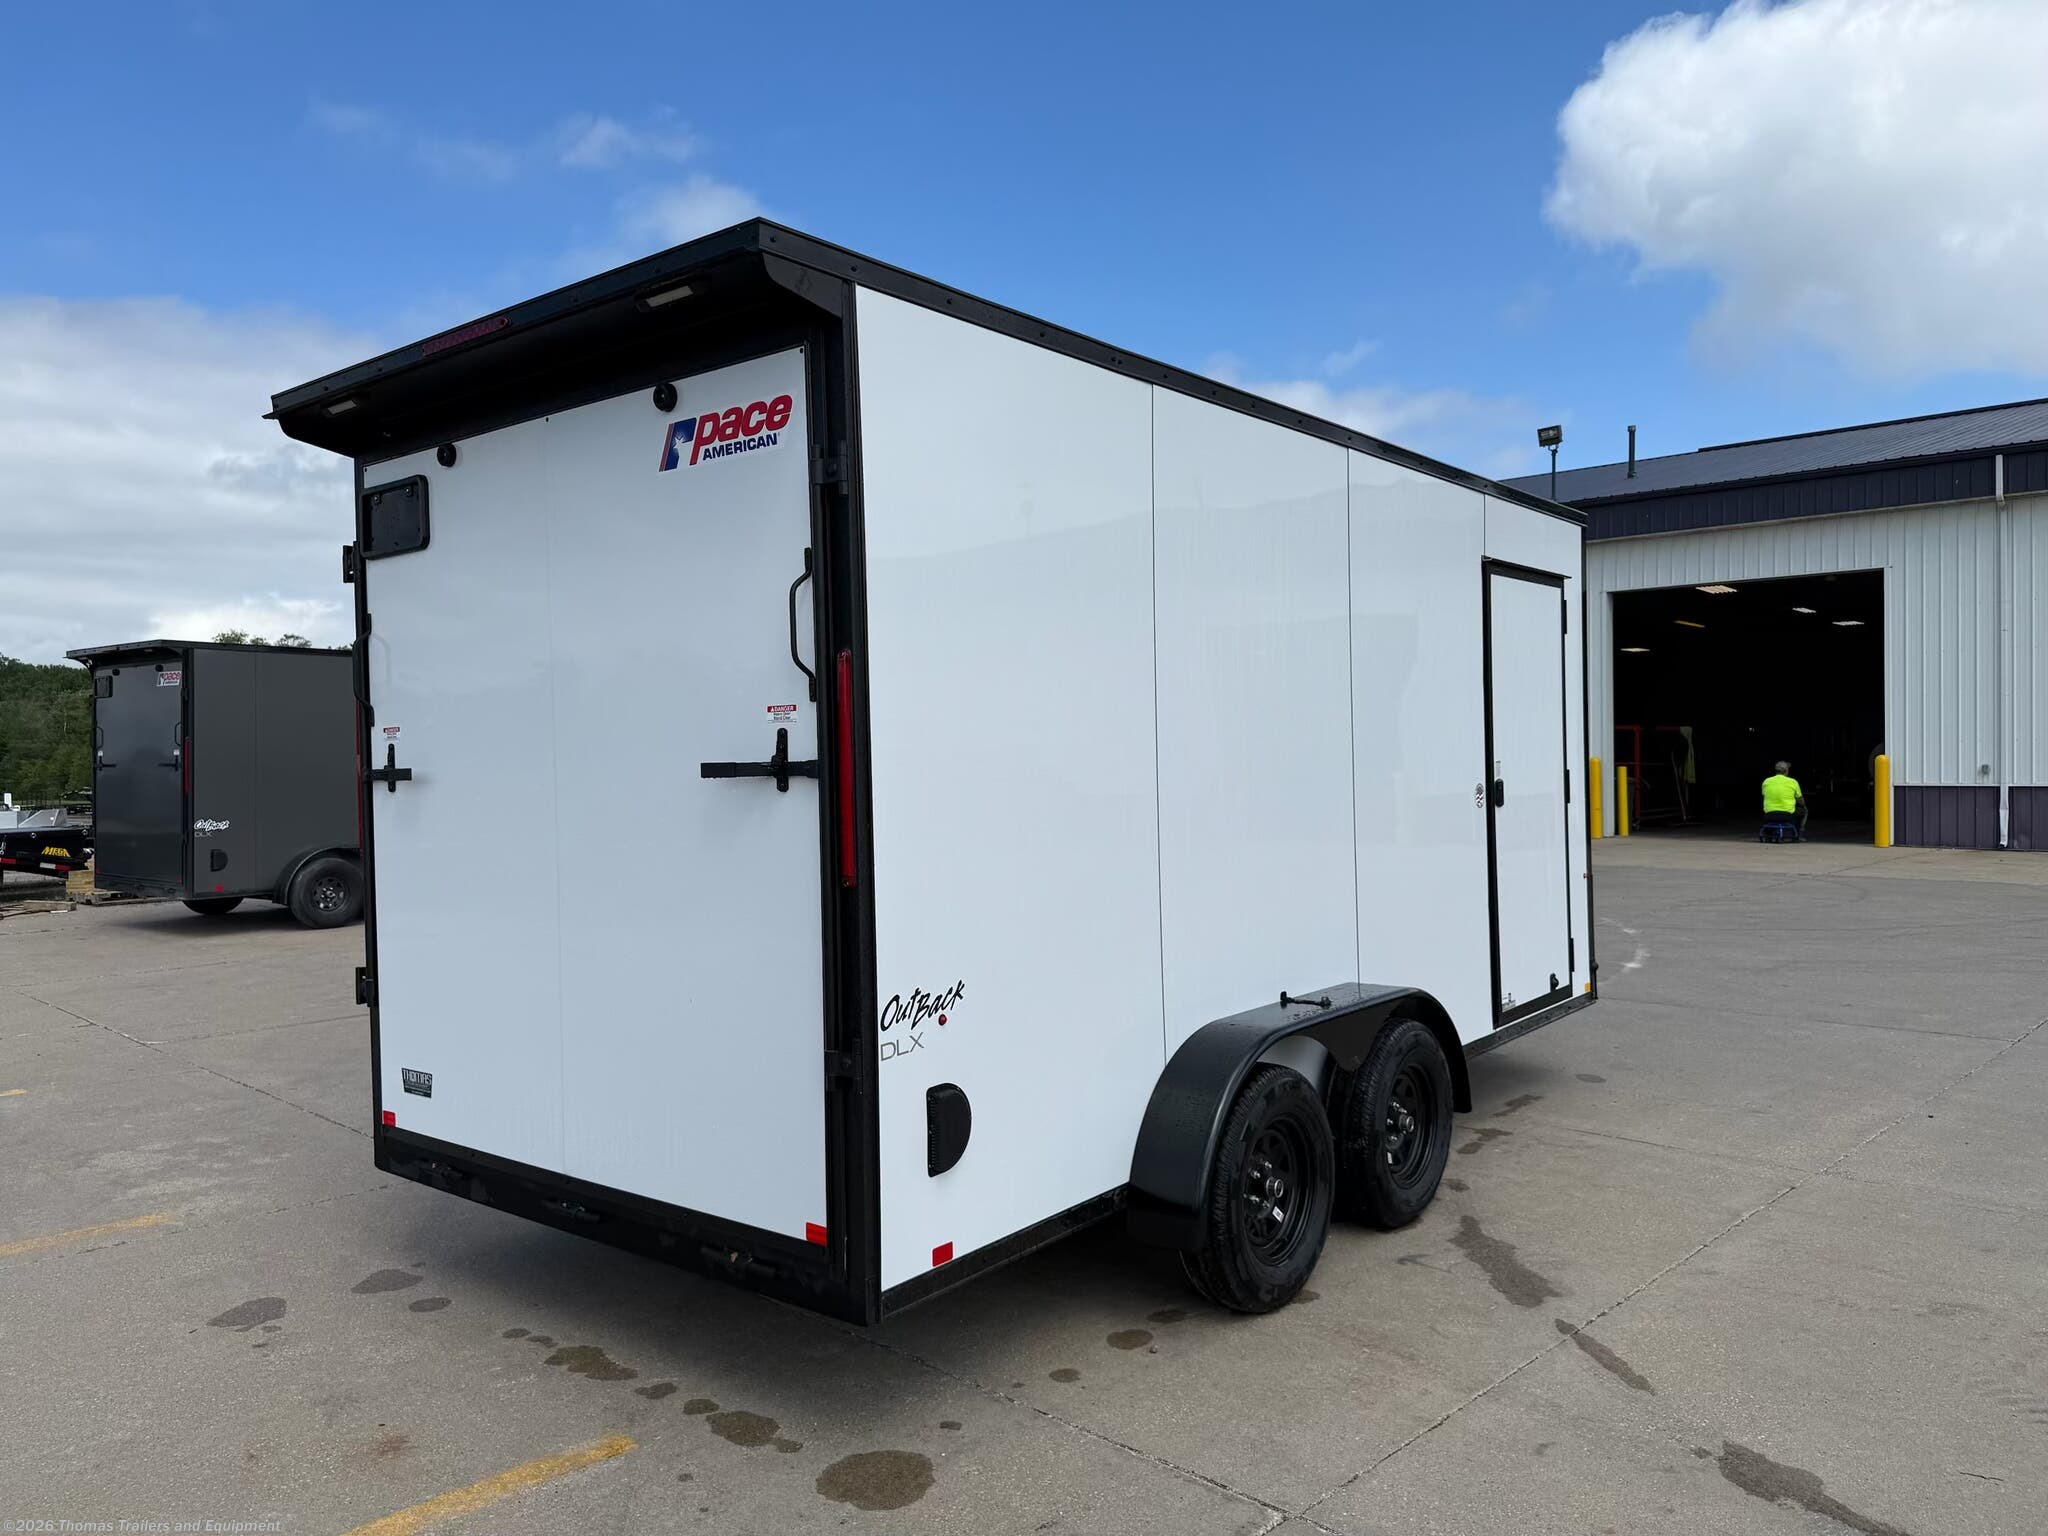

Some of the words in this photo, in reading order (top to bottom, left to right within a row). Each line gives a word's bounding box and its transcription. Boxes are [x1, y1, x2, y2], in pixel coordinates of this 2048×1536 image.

[690, 394, 792, 465] pace
[703, 433, 777, 461] AMERICAN
[42, 846, 71, 857] MEGA
[880, 1032, 924, 1061] DLX
